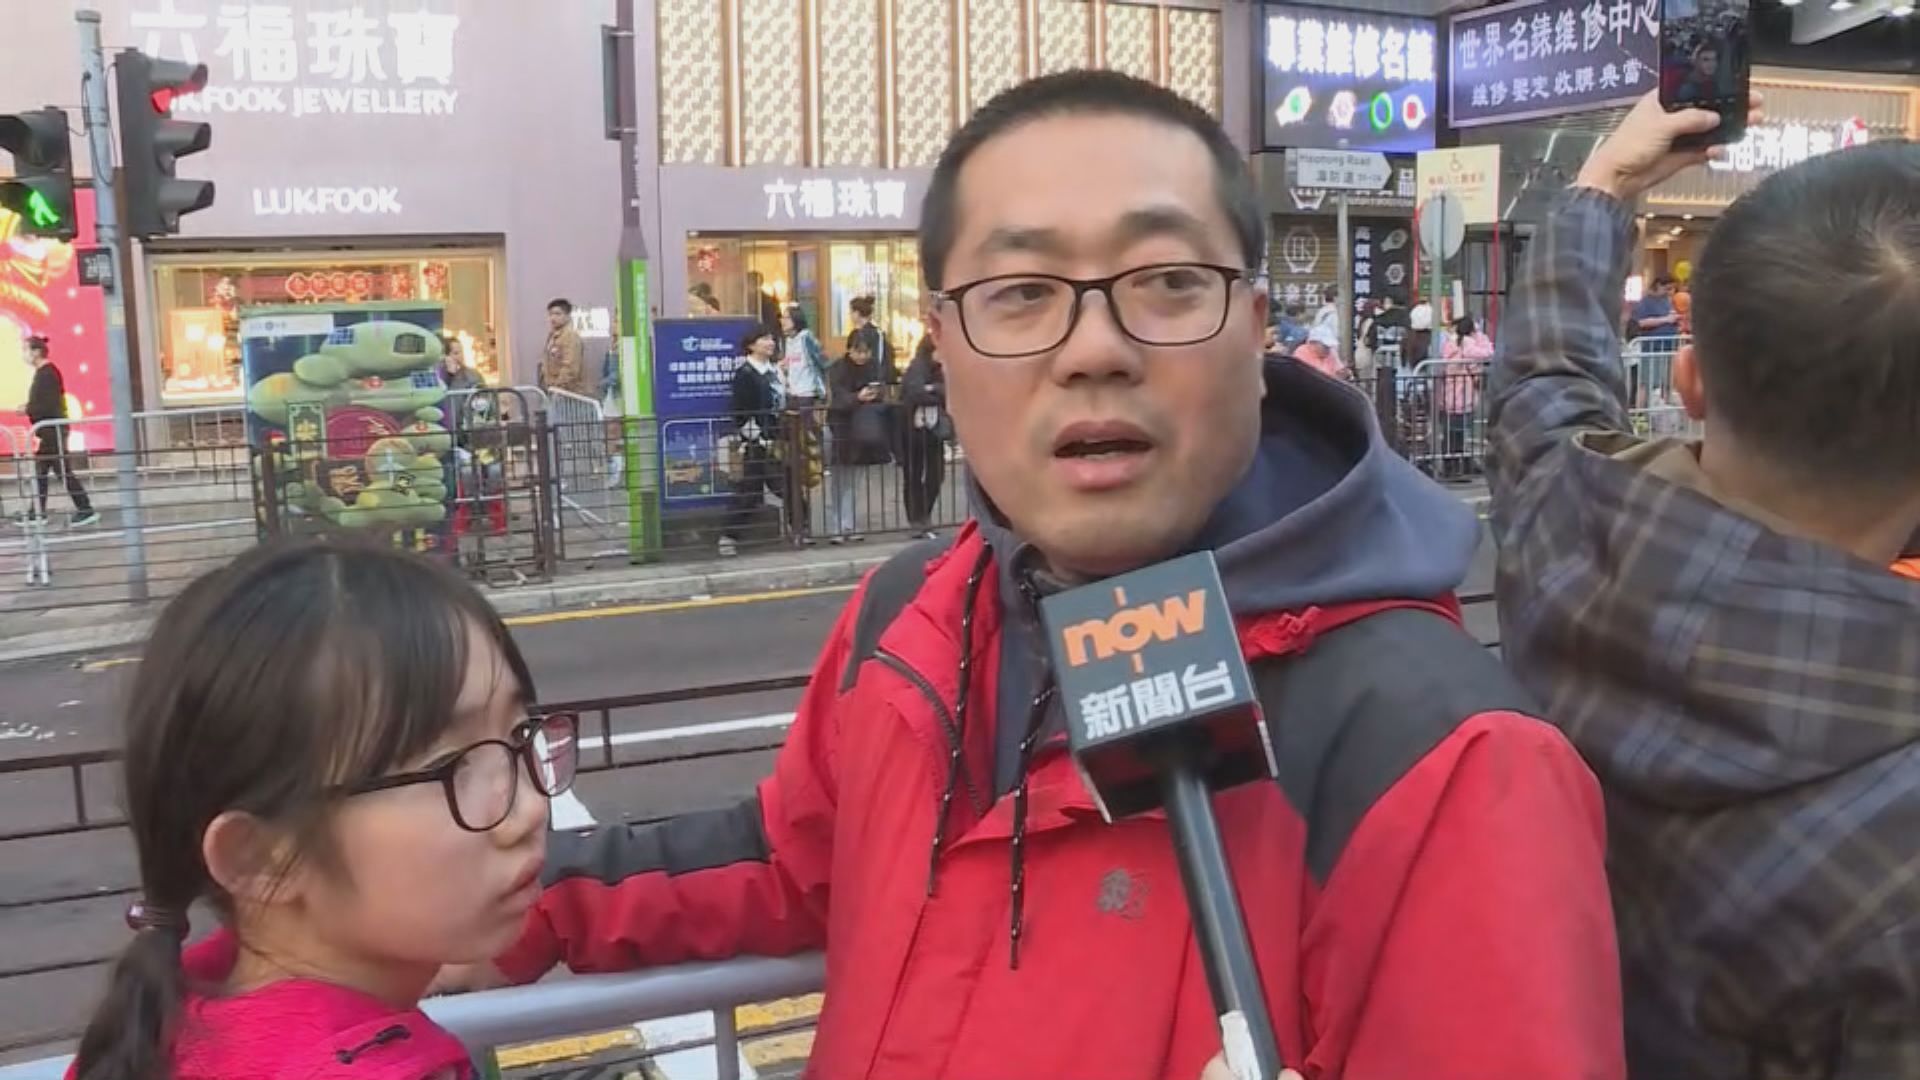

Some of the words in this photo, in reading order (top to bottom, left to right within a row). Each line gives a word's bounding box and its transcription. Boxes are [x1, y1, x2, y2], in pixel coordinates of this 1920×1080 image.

[130, 0, 459, 84] 六福珠寶
[292, 87, 458, 117] JEWELLERY
[253, 187, 402, 215] LUKFOOK
[763, 178, 906, 219] 六福珠寶
[1062, 586, 1207, 673] now
[1079, 660, 1236, 740] 新聞台
